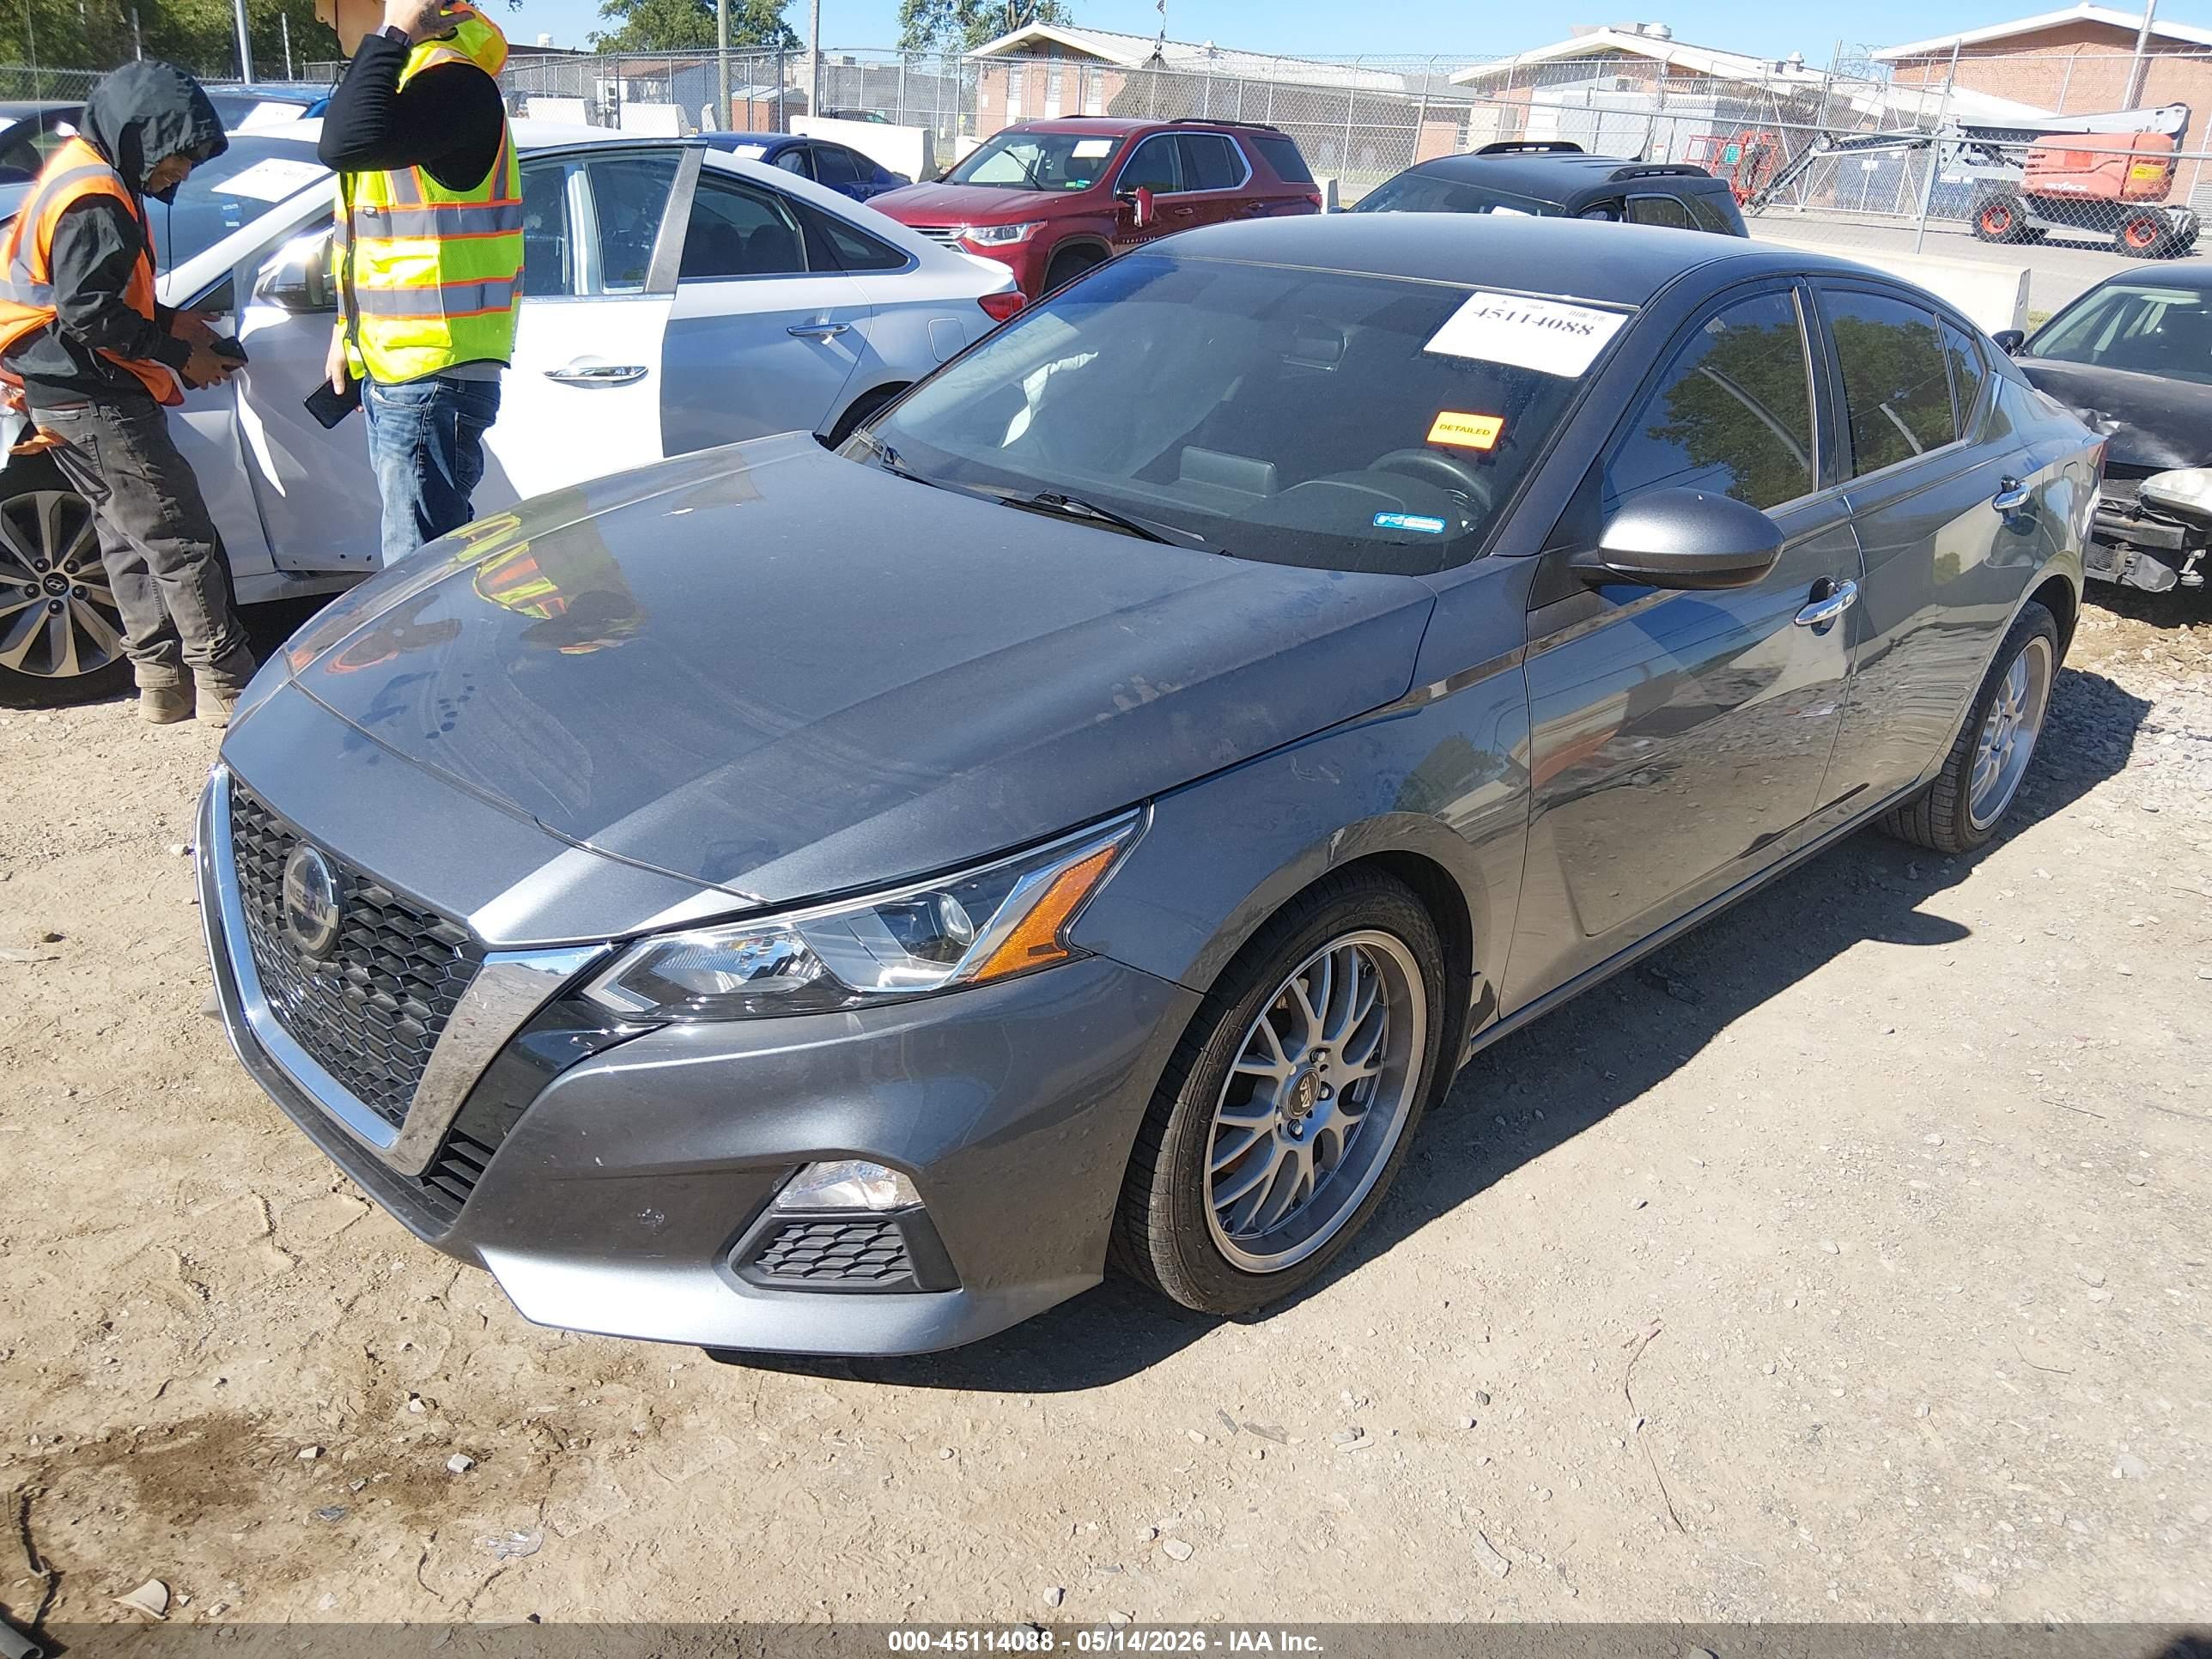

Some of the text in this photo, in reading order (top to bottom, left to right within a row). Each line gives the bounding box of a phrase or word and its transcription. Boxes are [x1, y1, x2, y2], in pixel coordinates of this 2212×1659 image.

[1473, 307, 1595, 336] 45114088
[1438, 423, 1491, 435] DETAILED
[288, 878, 328, 921] NISSAN
